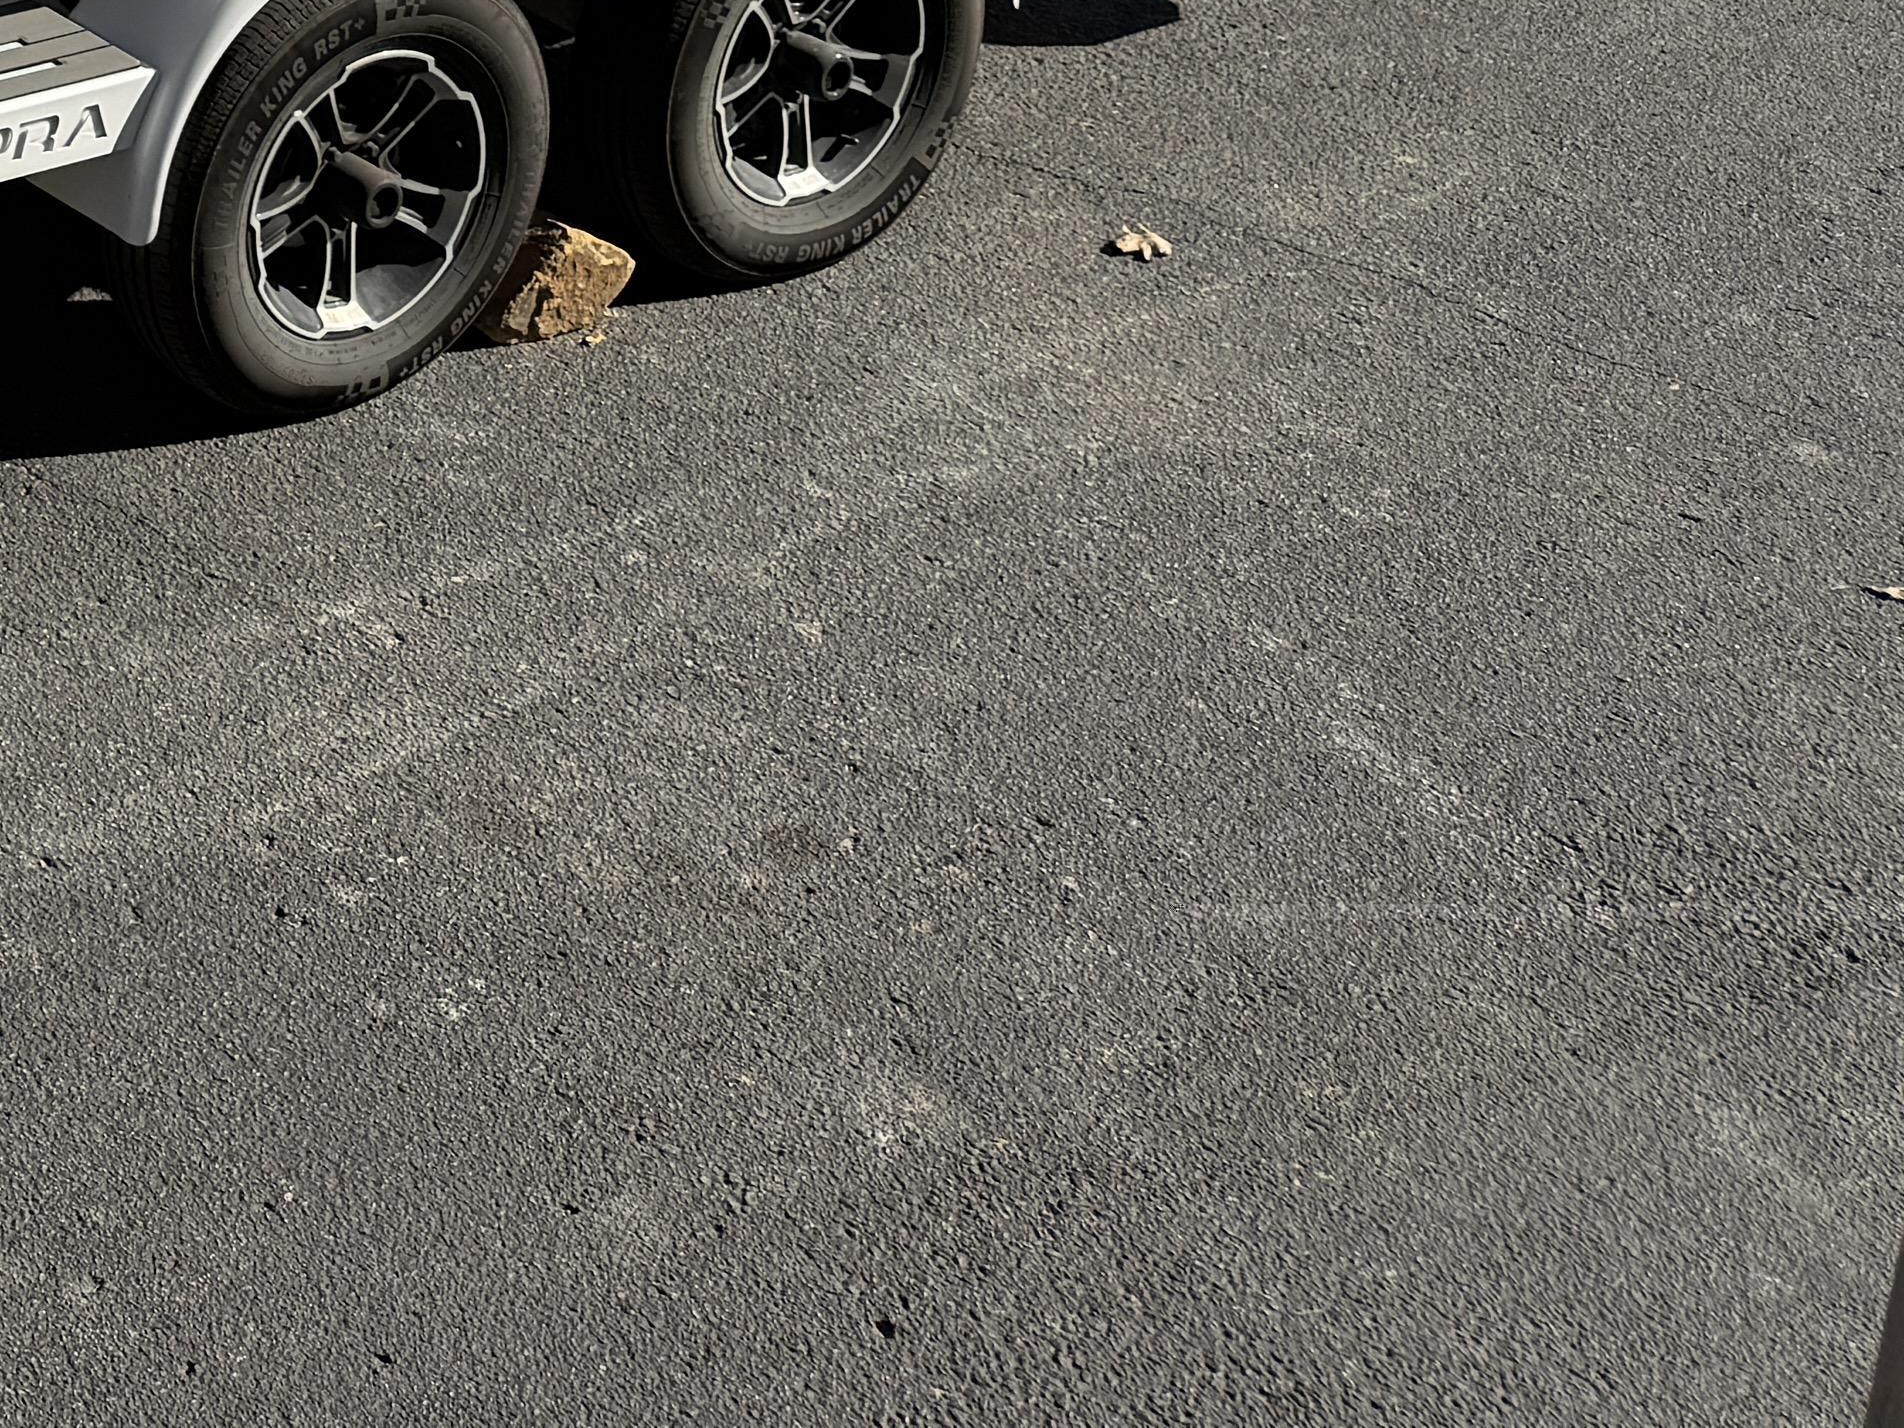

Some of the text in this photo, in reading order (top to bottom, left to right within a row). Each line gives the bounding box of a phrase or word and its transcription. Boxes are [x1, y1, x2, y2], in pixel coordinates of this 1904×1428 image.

[215, 121, 262, 230] TRAILER
[259, 56, 308, 118] KING
[492, 168, 536, 273] TRAILER
[850, 173, 921, 245] TRAILER
[795, 233, 846, 263] KING
[448, 279, 493, 334] KING
